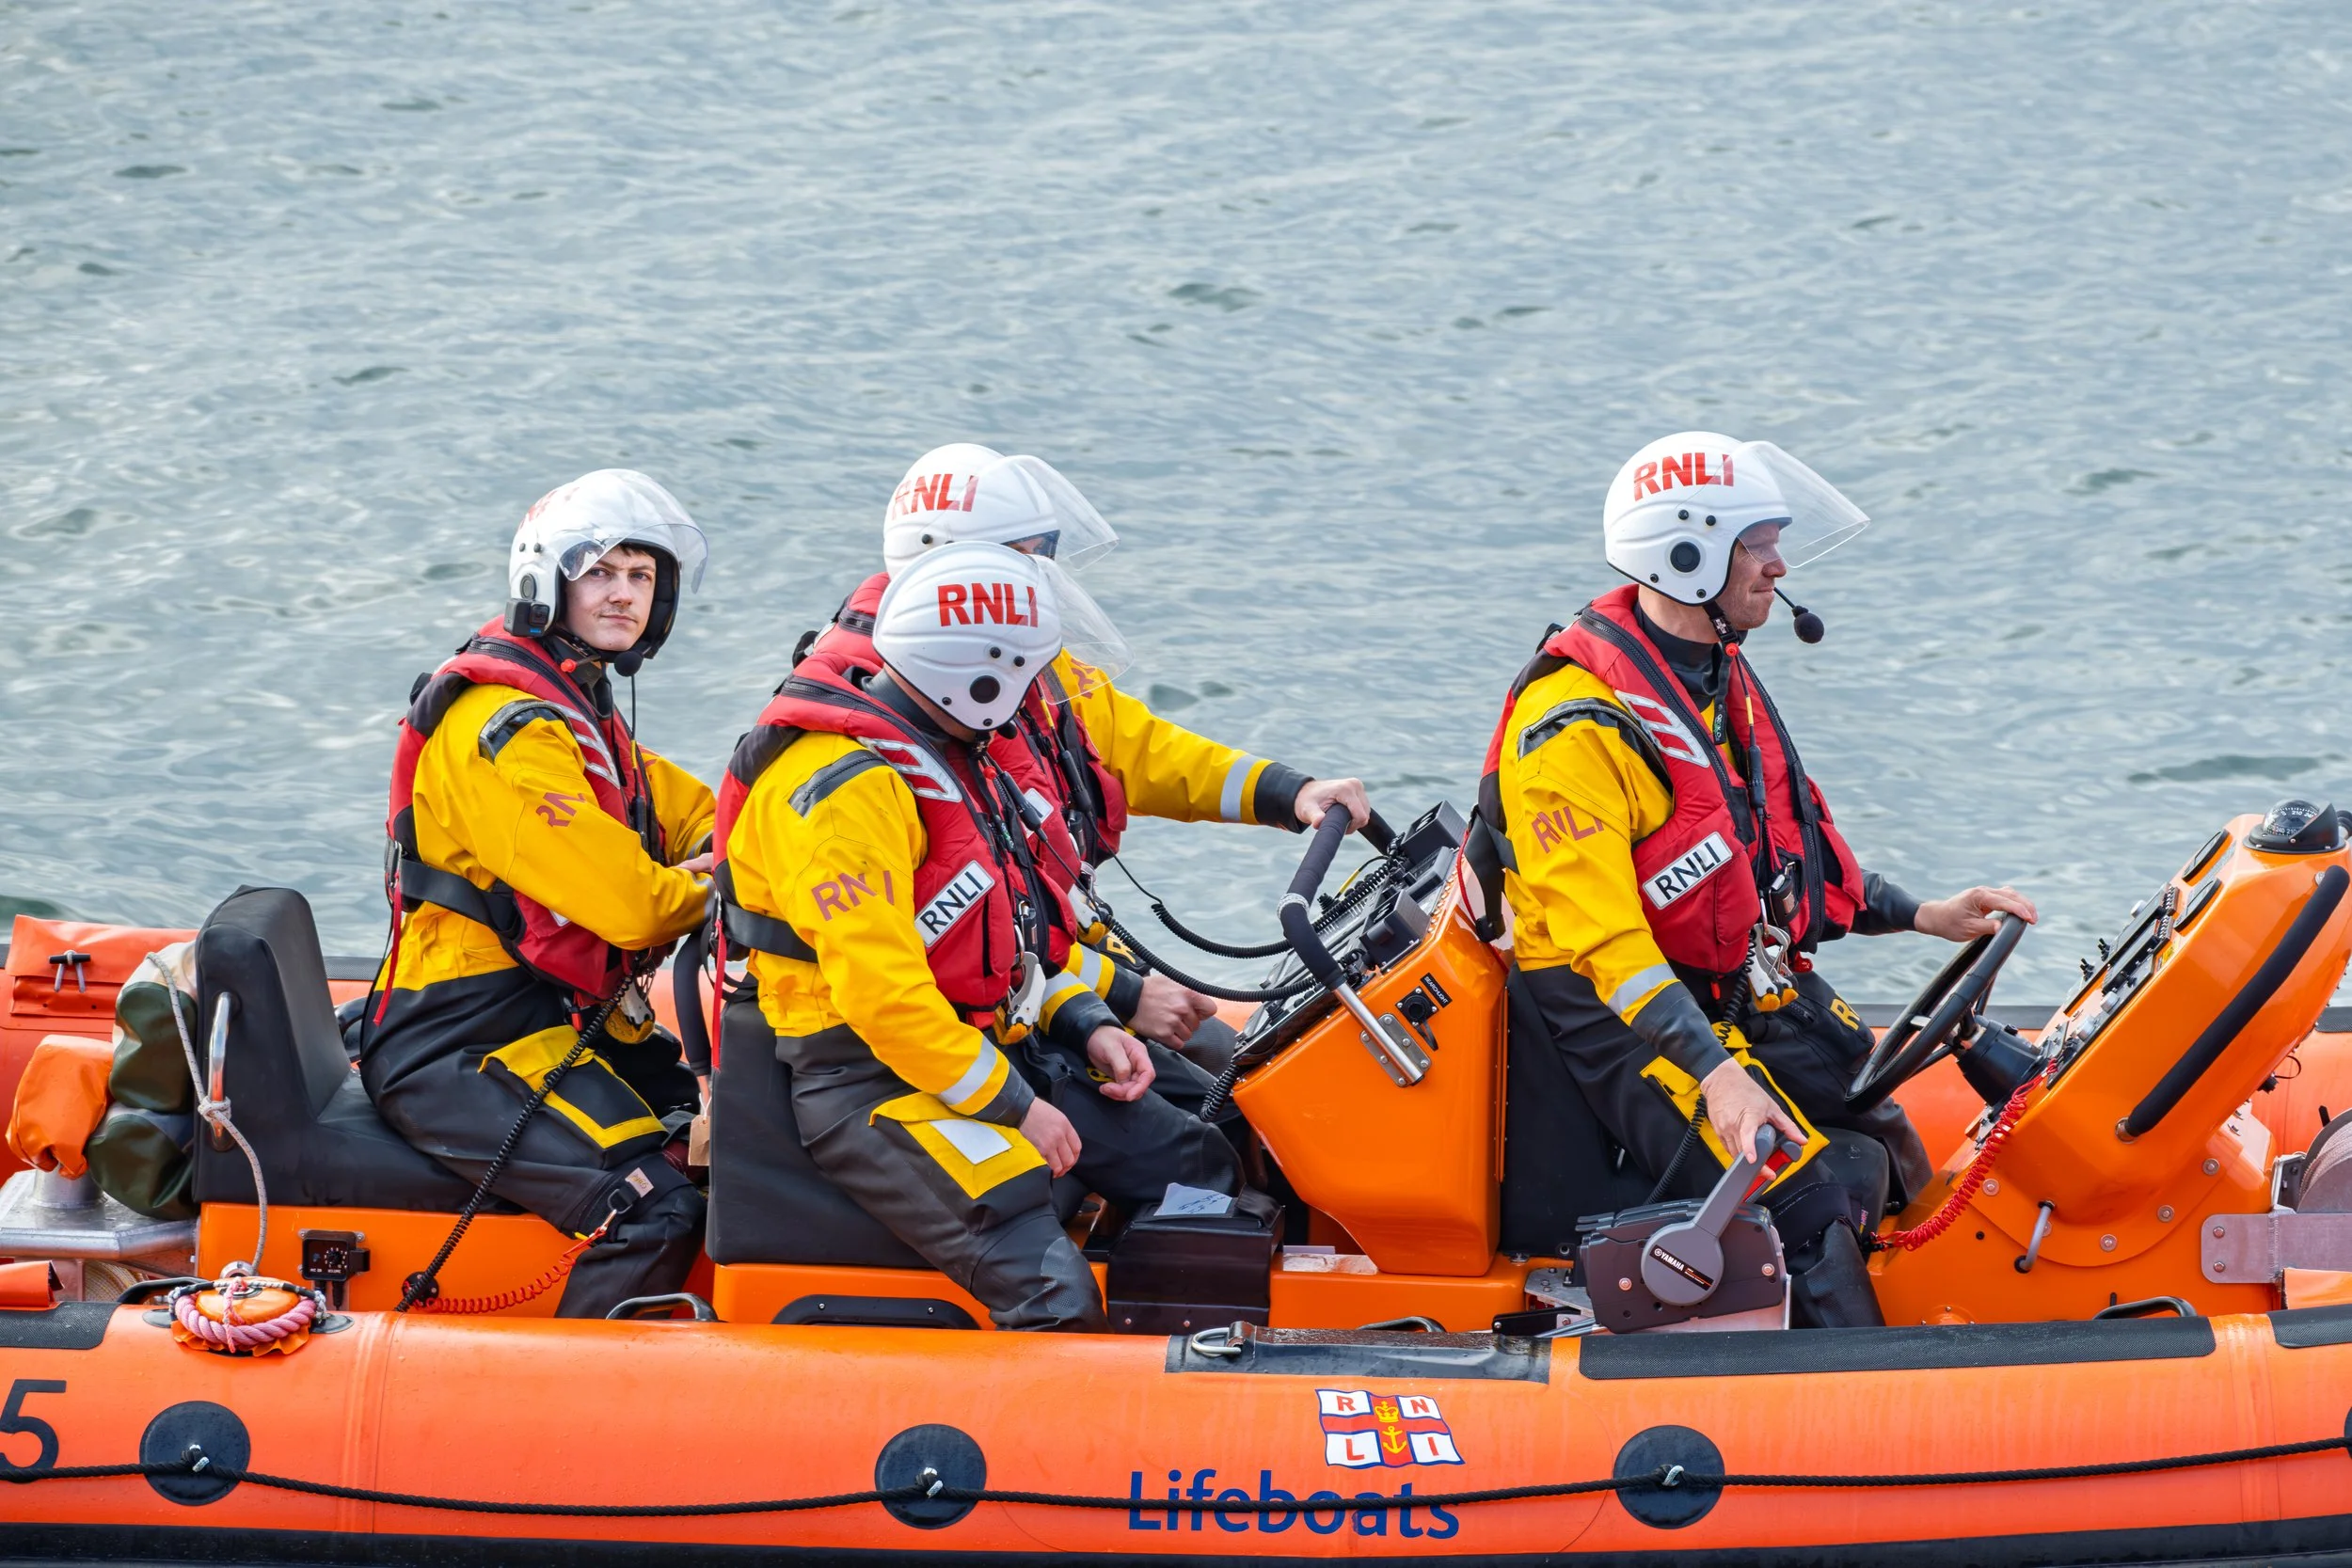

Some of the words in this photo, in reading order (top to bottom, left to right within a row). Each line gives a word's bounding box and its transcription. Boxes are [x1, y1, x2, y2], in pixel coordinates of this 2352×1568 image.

[892, 473, 979, 520] RNLI
[1633, 451, 1734, 501] RNLI
[937, 583, 1040, 628] RNLI
[811, 869, 896, 922] RNI
[1655, 842, 1723, 901] RNLI
[920, 871, 984, 936] RNLI
[1661, 1251, 1685, 1272] YAMAHA
[1337, 1395, 1356, 1412] R
[1409, 1398, 1429, 1414] N
[0, 1379, 68, 1484] 5
[1345, 1438, 1365, 1461] L
[1427, 1436, 1440, 1457] I
[1128, 1467, 1460, 1540] Lifeboats
